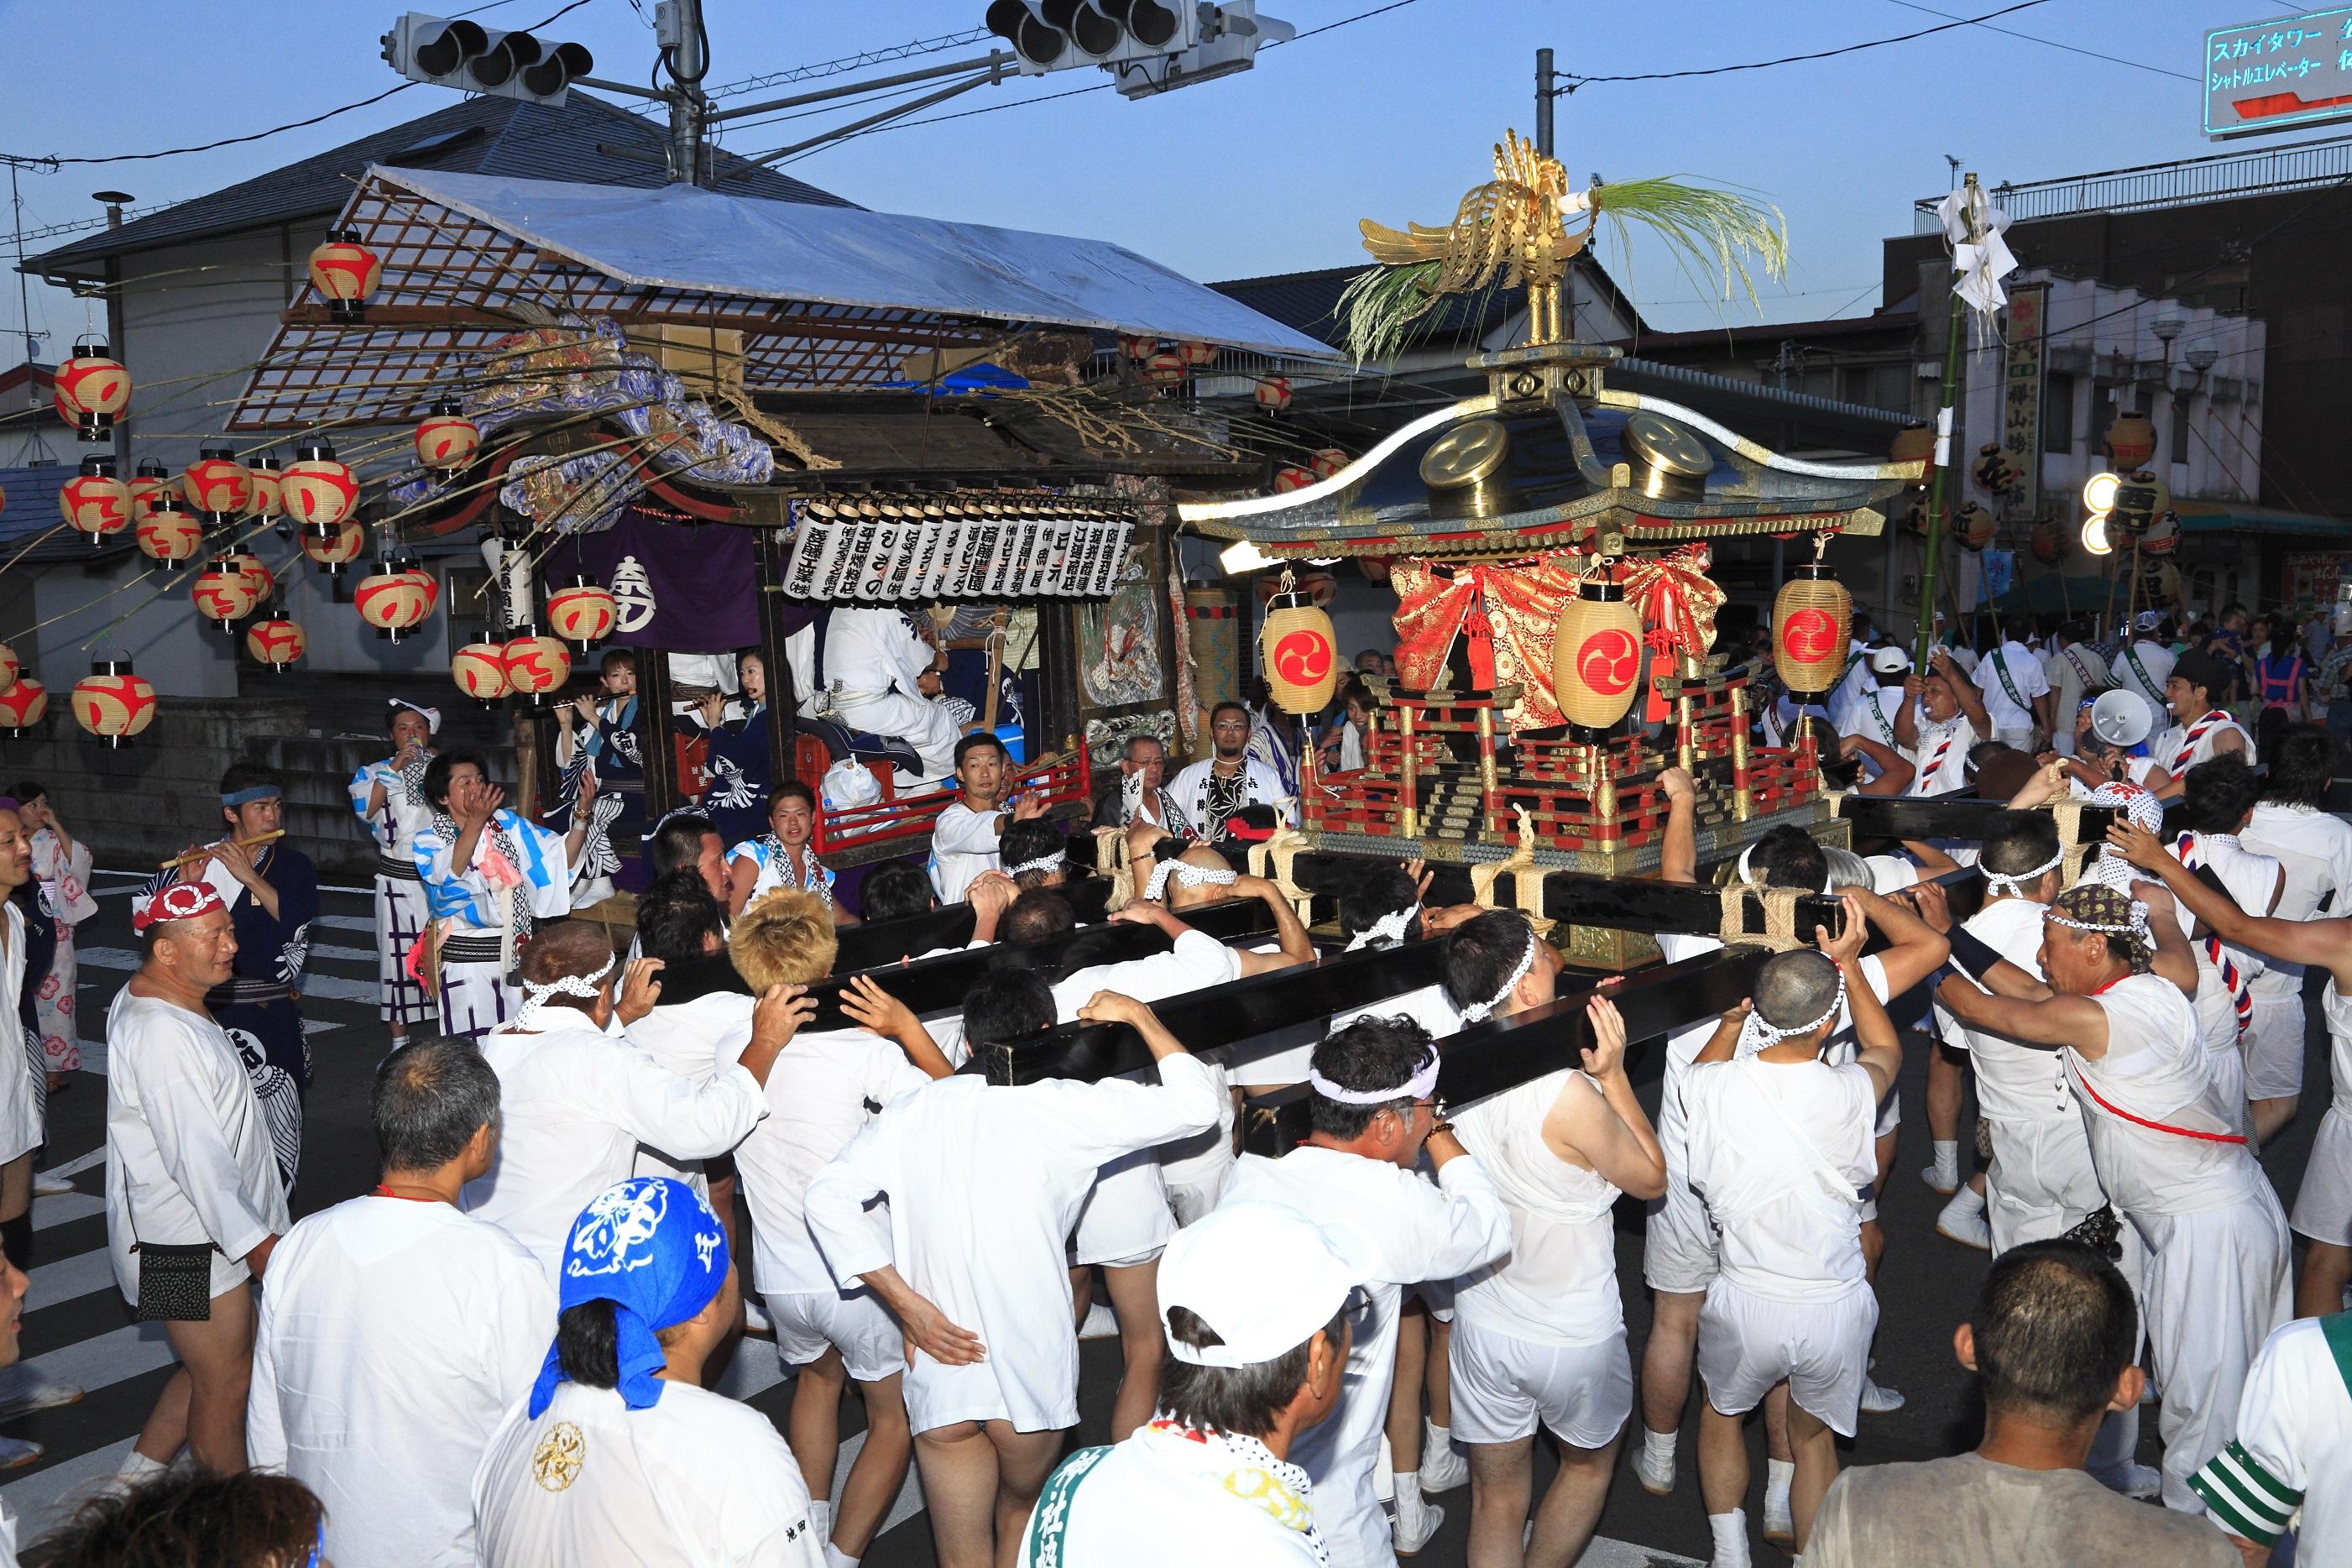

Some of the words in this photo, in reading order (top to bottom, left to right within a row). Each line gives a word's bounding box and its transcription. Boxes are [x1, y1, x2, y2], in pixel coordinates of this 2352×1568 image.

[2213, 28, 2322, 62] スカイタワー
[2212, 57, 2322, 91] シャトルエレベーター
[865, 530, 897, 595] ひさの
[785, 1519, 806, 1544] 池田
